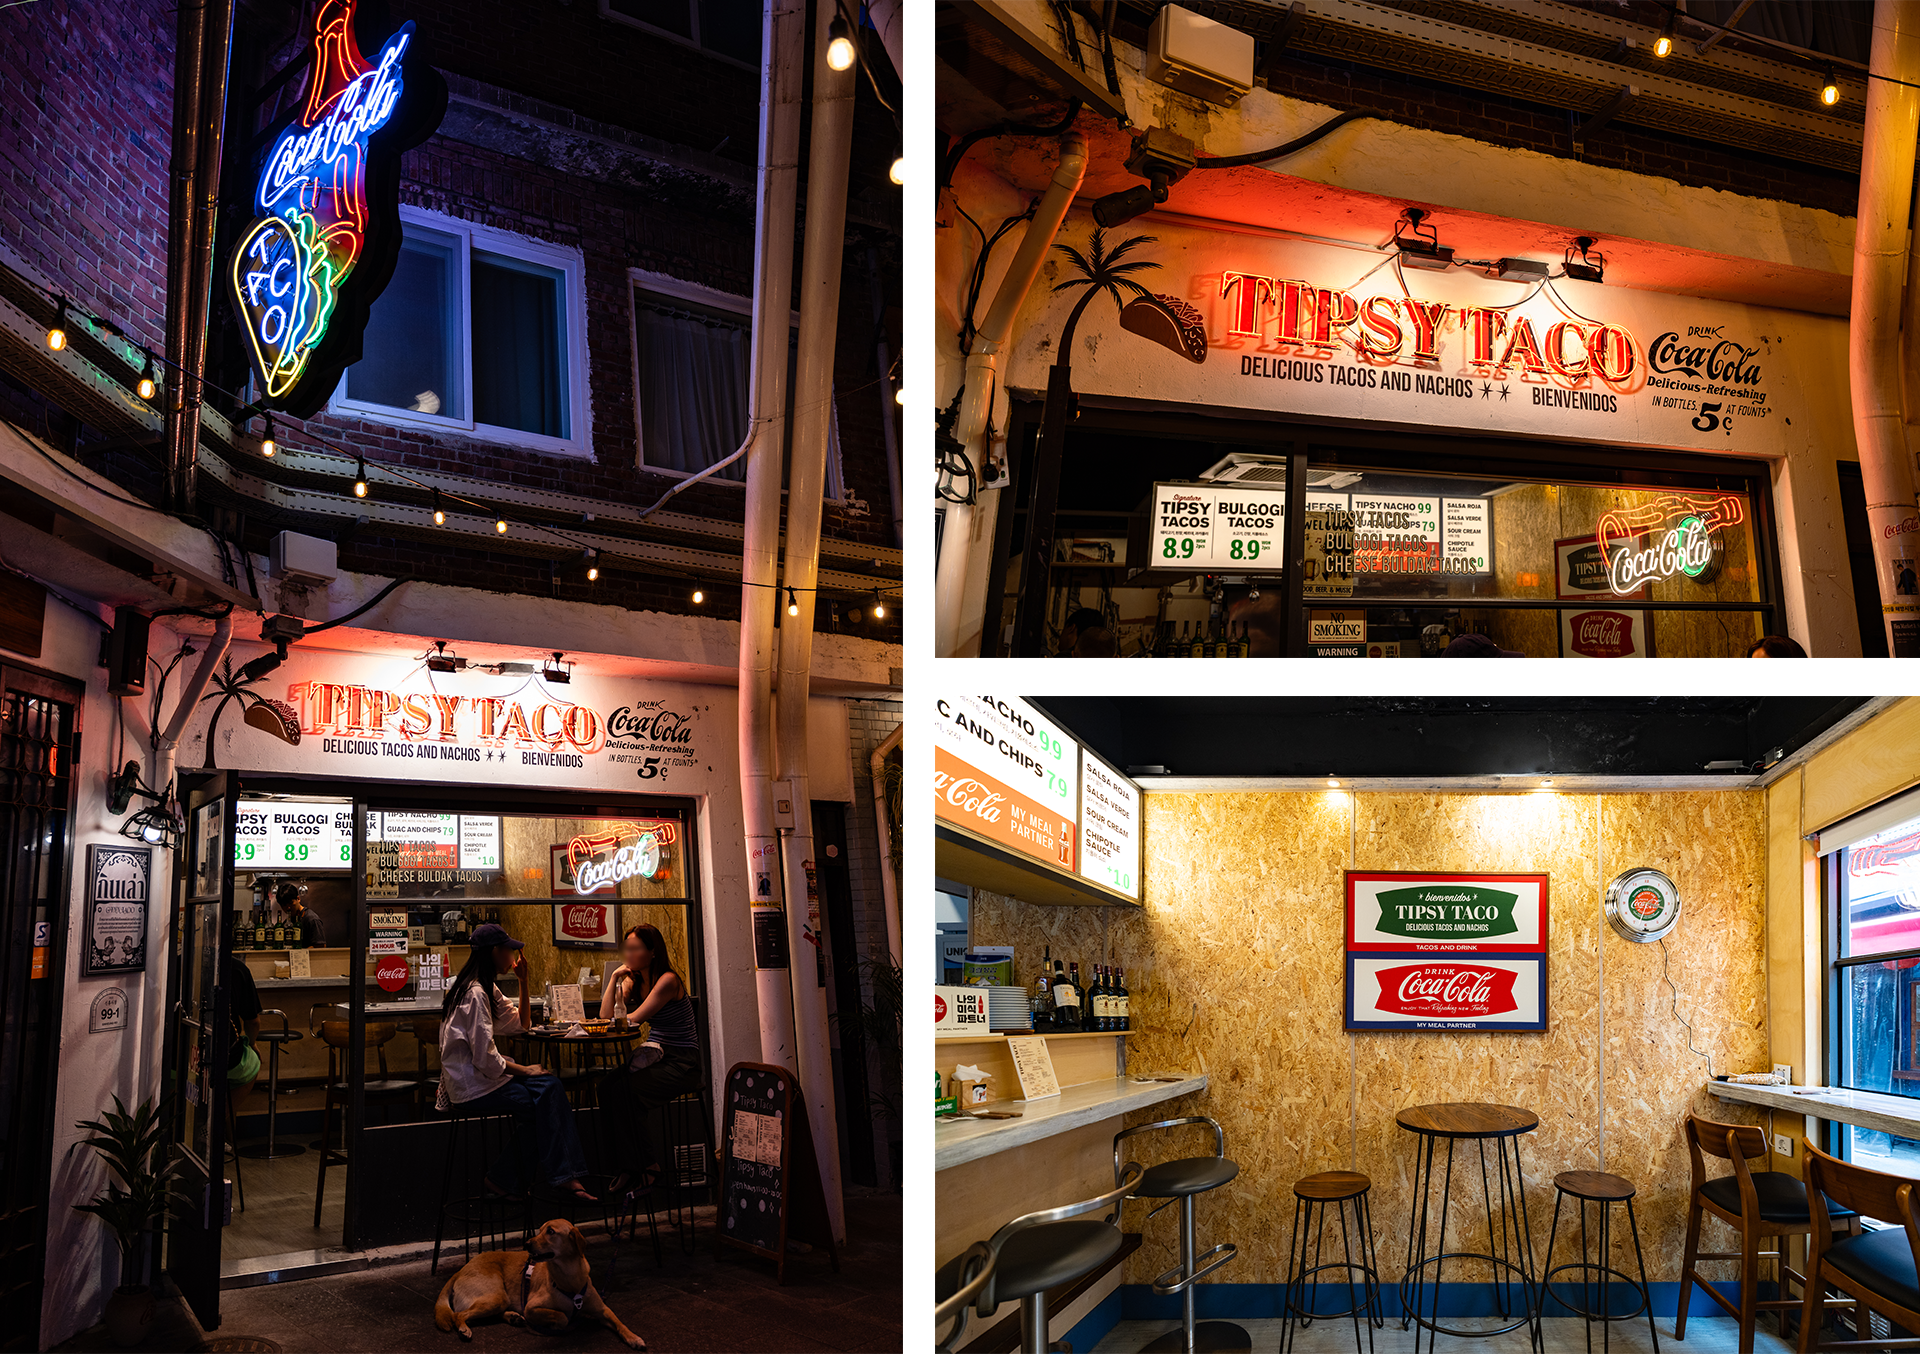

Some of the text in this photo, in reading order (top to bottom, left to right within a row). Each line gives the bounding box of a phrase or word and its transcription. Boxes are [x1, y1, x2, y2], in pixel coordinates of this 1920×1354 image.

[261, 33, 411, 207] Coca-Cola
[1220, 271, 1638, 383] TIPSY TACO
[1687, 325, 1725, 339] DRINK
[1648, 332, 1763, 386] Coca-Cola
[1241, 355, 1473, 398] DELICIOUS TACOS AND NACHOS
[1646, 375, 1766, 404] Delicious-Refreshing
[1532, 386, 1617, 413] BIENVENIDOS
[1652, 396, 1660, 406] IN
[1726, 404, 1736, 415] AT
[1173, 494, 1201, 503] Signature
[1161, 501, 1211, 515] TIPSY
[1218, 502, 1284, 516] BULGOGI
[1356, 501, 1432, 514] TIPSY NACHO 9.9
[1161, 516, 1209, 528] TACOS
[1227, 517, 1274, 528] TACOS
[1325, 510, 1410, 530] TIPSY TACOS
[1422, 521, 1435, 532] 7.9
[1883, 516, 1919, 539] Coca-Cola
[1163, 537, 1194, 559] 8.9
[1230, 539, 1260, 560] 8.9
[1325, 533, 1428, 552] BULGOGI TACOS
[1612, 518, 1712, 595] Coca-Cola
[1325, 555, 1478, 575] CHEESE BULDAK TACOS
[1330, 612, 1345, 624] NO
[1314, 624, 1361, 636] SMOKING
[1579, 617, 1622, 645] Coca-Cola
[1317, 648, 1358, 656] WARNING
[637, 700, 666, 711] DRINK
[309, 680, 600, 747] TIPSY TACO
[606, 706, 692, 744] Coca-Cola
[323, 738, 481, 762] DELICIOUS TACOS AND NACHOS
[605, 740, 695, 758] Delicious-Refreshing
[1039, 730, 1062, 760] 9.9
[522, 751, 583, 768] BIENVENIDOS
[608, 754, 615, 762] IN
[663, 758, 671, 766] AT
[955, 712, 1067, 798] AND CHIPS 7.9
[1086, 763, 1130, 801] SALSA ROJA
[935, 770, 1007, 824] a-Cola
[1086, 784, 1130, 819] SALSA VERDE
[274, 813, 328, 824] BULGOGI
[1011, 804, 1054, 837] MY MEAL
[1086, 806, 1129, 838] SOUR CREAM
[282, 826, 320, 835] TACOS
[443, 827, 454, 836] 7.9
[1011, 820, 1054, 850] PARTNER
[380, 840, 406, 852] TIPSY
[408, 840, 437, 852] TACOS
[1085, 828, 1121, 854] CHIPOTLE
[1086, 838, 1112, 858] SAUCE
[284, 844, 309, 861] 8.9
[752, 844, 775, 859] Coca-Cola
[380, 855, 419, 867] BULGOGI
[420, 855, 449, 867] TACOS
[577, 839, 652, 895] Coca-Cola
[380, 870, 483, 882] CHEESE BULDAK TACOS
[1425, 892, 1471, 902] bienvenidos
[384, 908, 394, 916] NO
[568, 906, 599, 928] Coca-Cola
[1395, 905, 1499, 920] TIPSY TACO
[373, 916, 404, 925] SMOKING
[1405, 923, 1489, 932] DELICIOUS TACOS AND NACHOS
[419, 953, 441, 966] 나의
[377, 967, 407, 980] Coca-Cola
[419, 966, 441, 978] 미식
[419, 979, 452, 991] 파트너
[1398, 971, 1497, 1003] Coca-Cola
[957, 994, 976, 1004] 나의
[101, 1007, 119, 1020] 99-1
[957, 1004, 977, 1014] 미식
[957, 1014, 986, 1023] 파트너
[740, 1094, 757, 1109] Tipsy
[735, 1159, 774, 1179] Tipsy Taco
